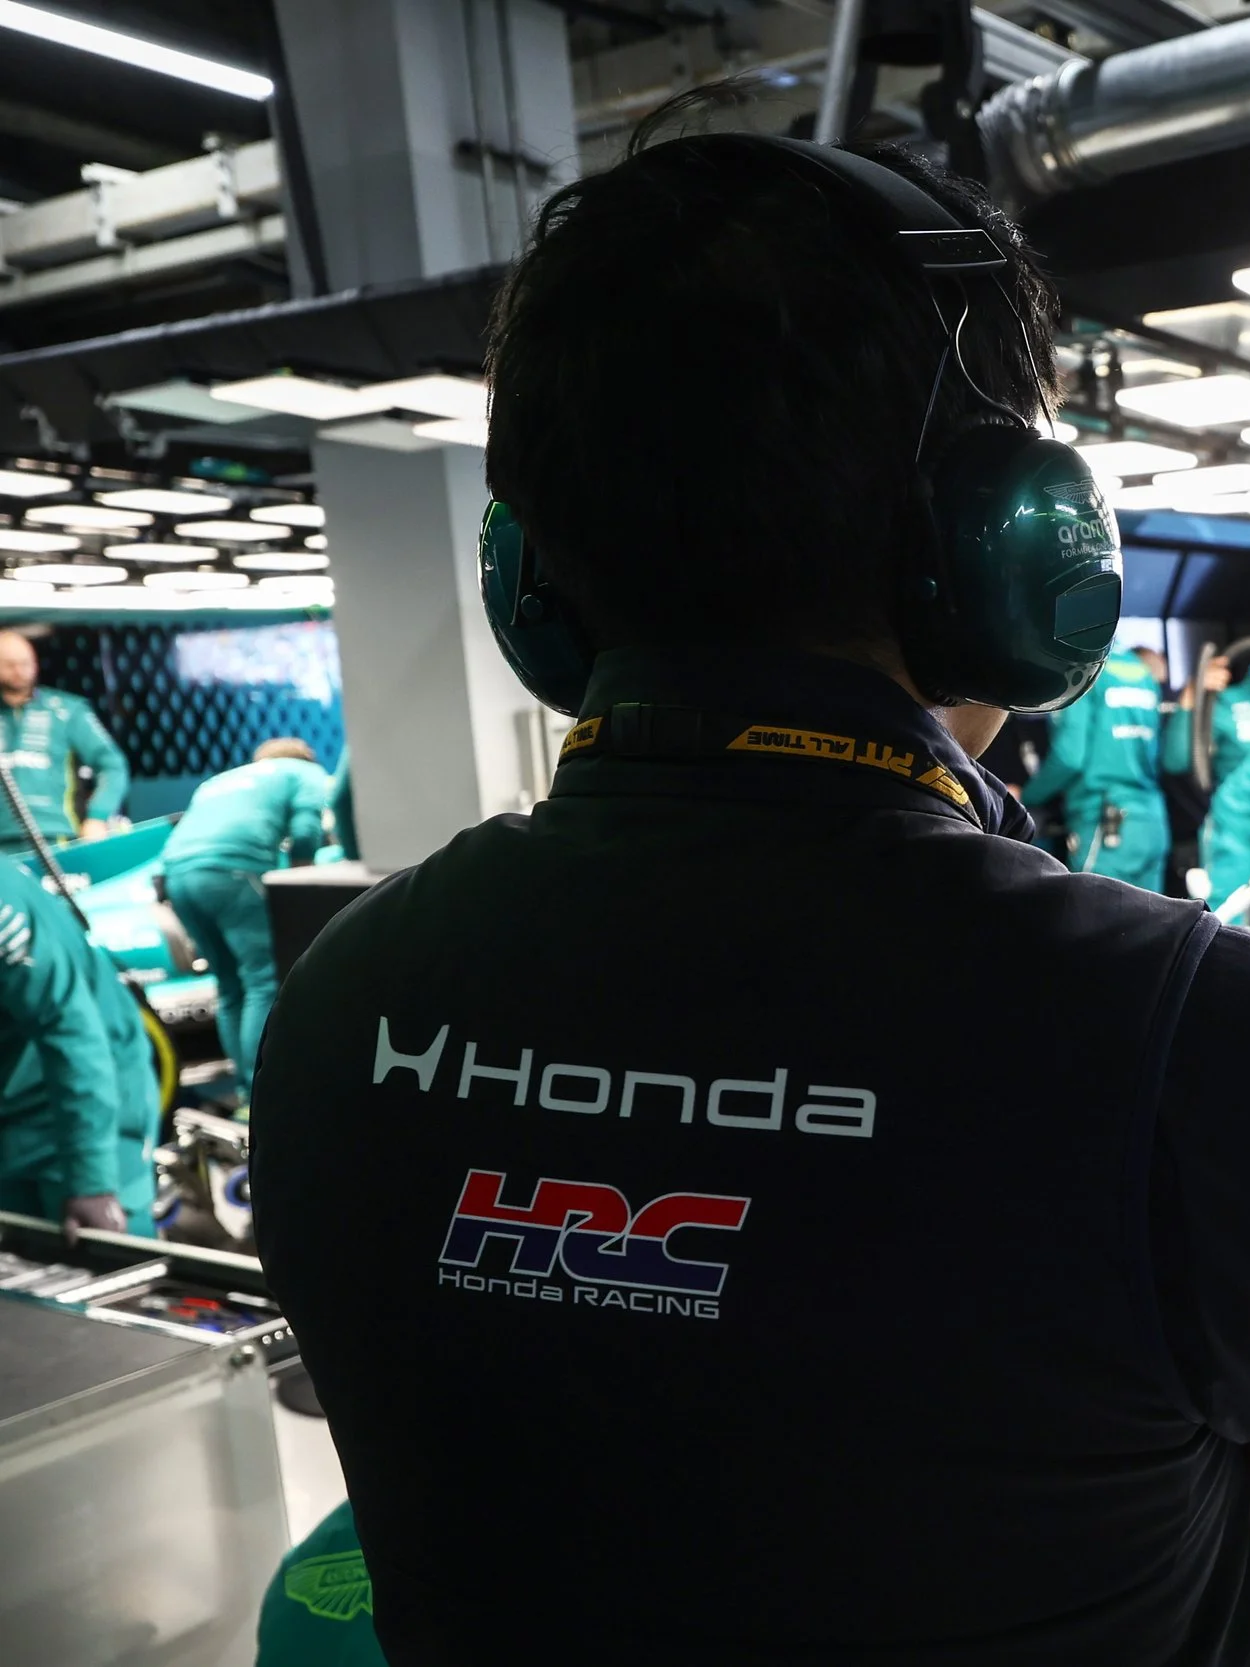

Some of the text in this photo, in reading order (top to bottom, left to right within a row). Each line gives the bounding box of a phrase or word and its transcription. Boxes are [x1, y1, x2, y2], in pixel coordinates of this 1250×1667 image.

[1058, 519, 1106, 543] aram
[747, 730, 806, 750] TIME
[809, 736, 850, 754] ALL
[856, 742, 915, 777] PIT
[457, 1041, 878, 1138] Honda
[438, 1168, 753, 1297] HRC
[438, 1267, 720, 1320] Honda RACING
